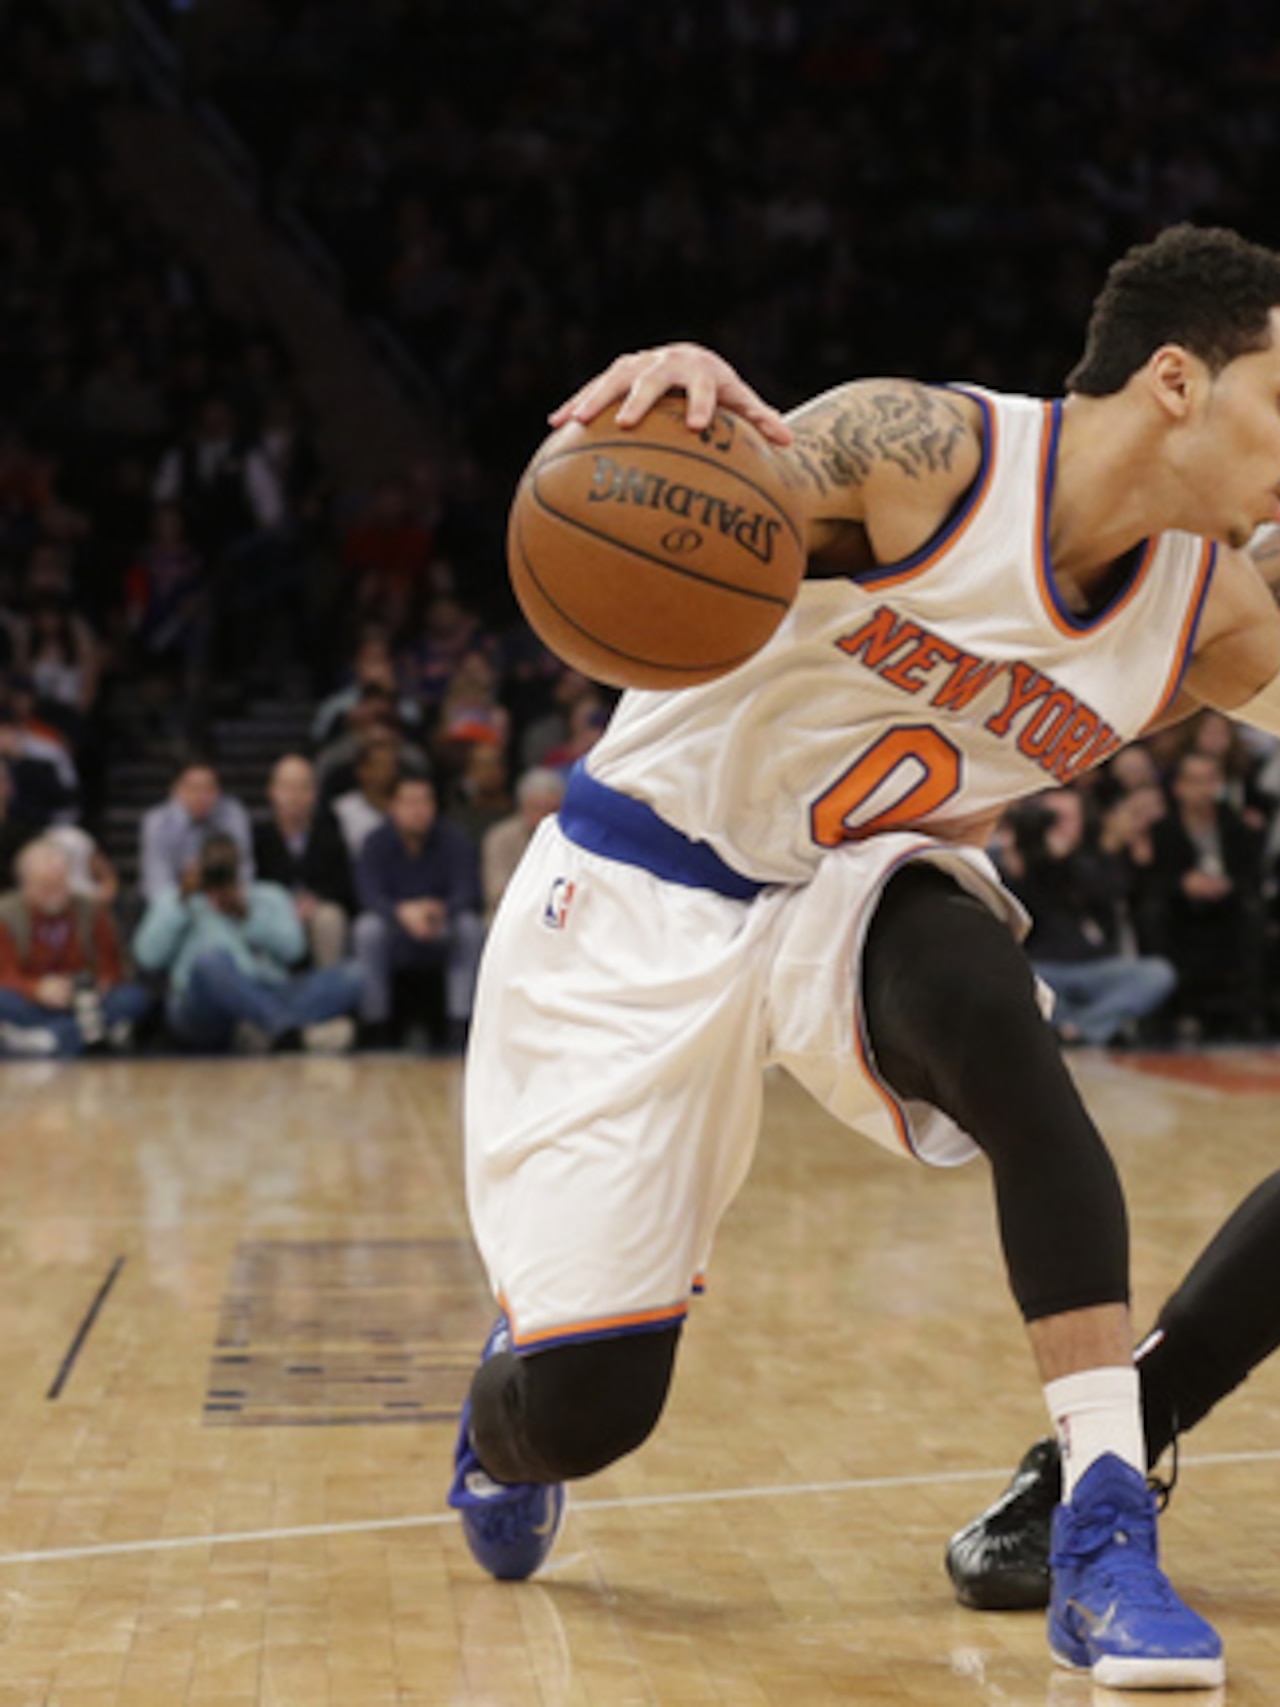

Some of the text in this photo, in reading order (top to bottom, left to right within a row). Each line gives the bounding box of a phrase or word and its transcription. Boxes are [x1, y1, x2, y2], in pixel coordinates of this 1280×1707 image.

[587, 454, 782, 565] SPALDING
[834, 605, 1124, 784] NEW YORK
[811, 724, 962, 847] 0
